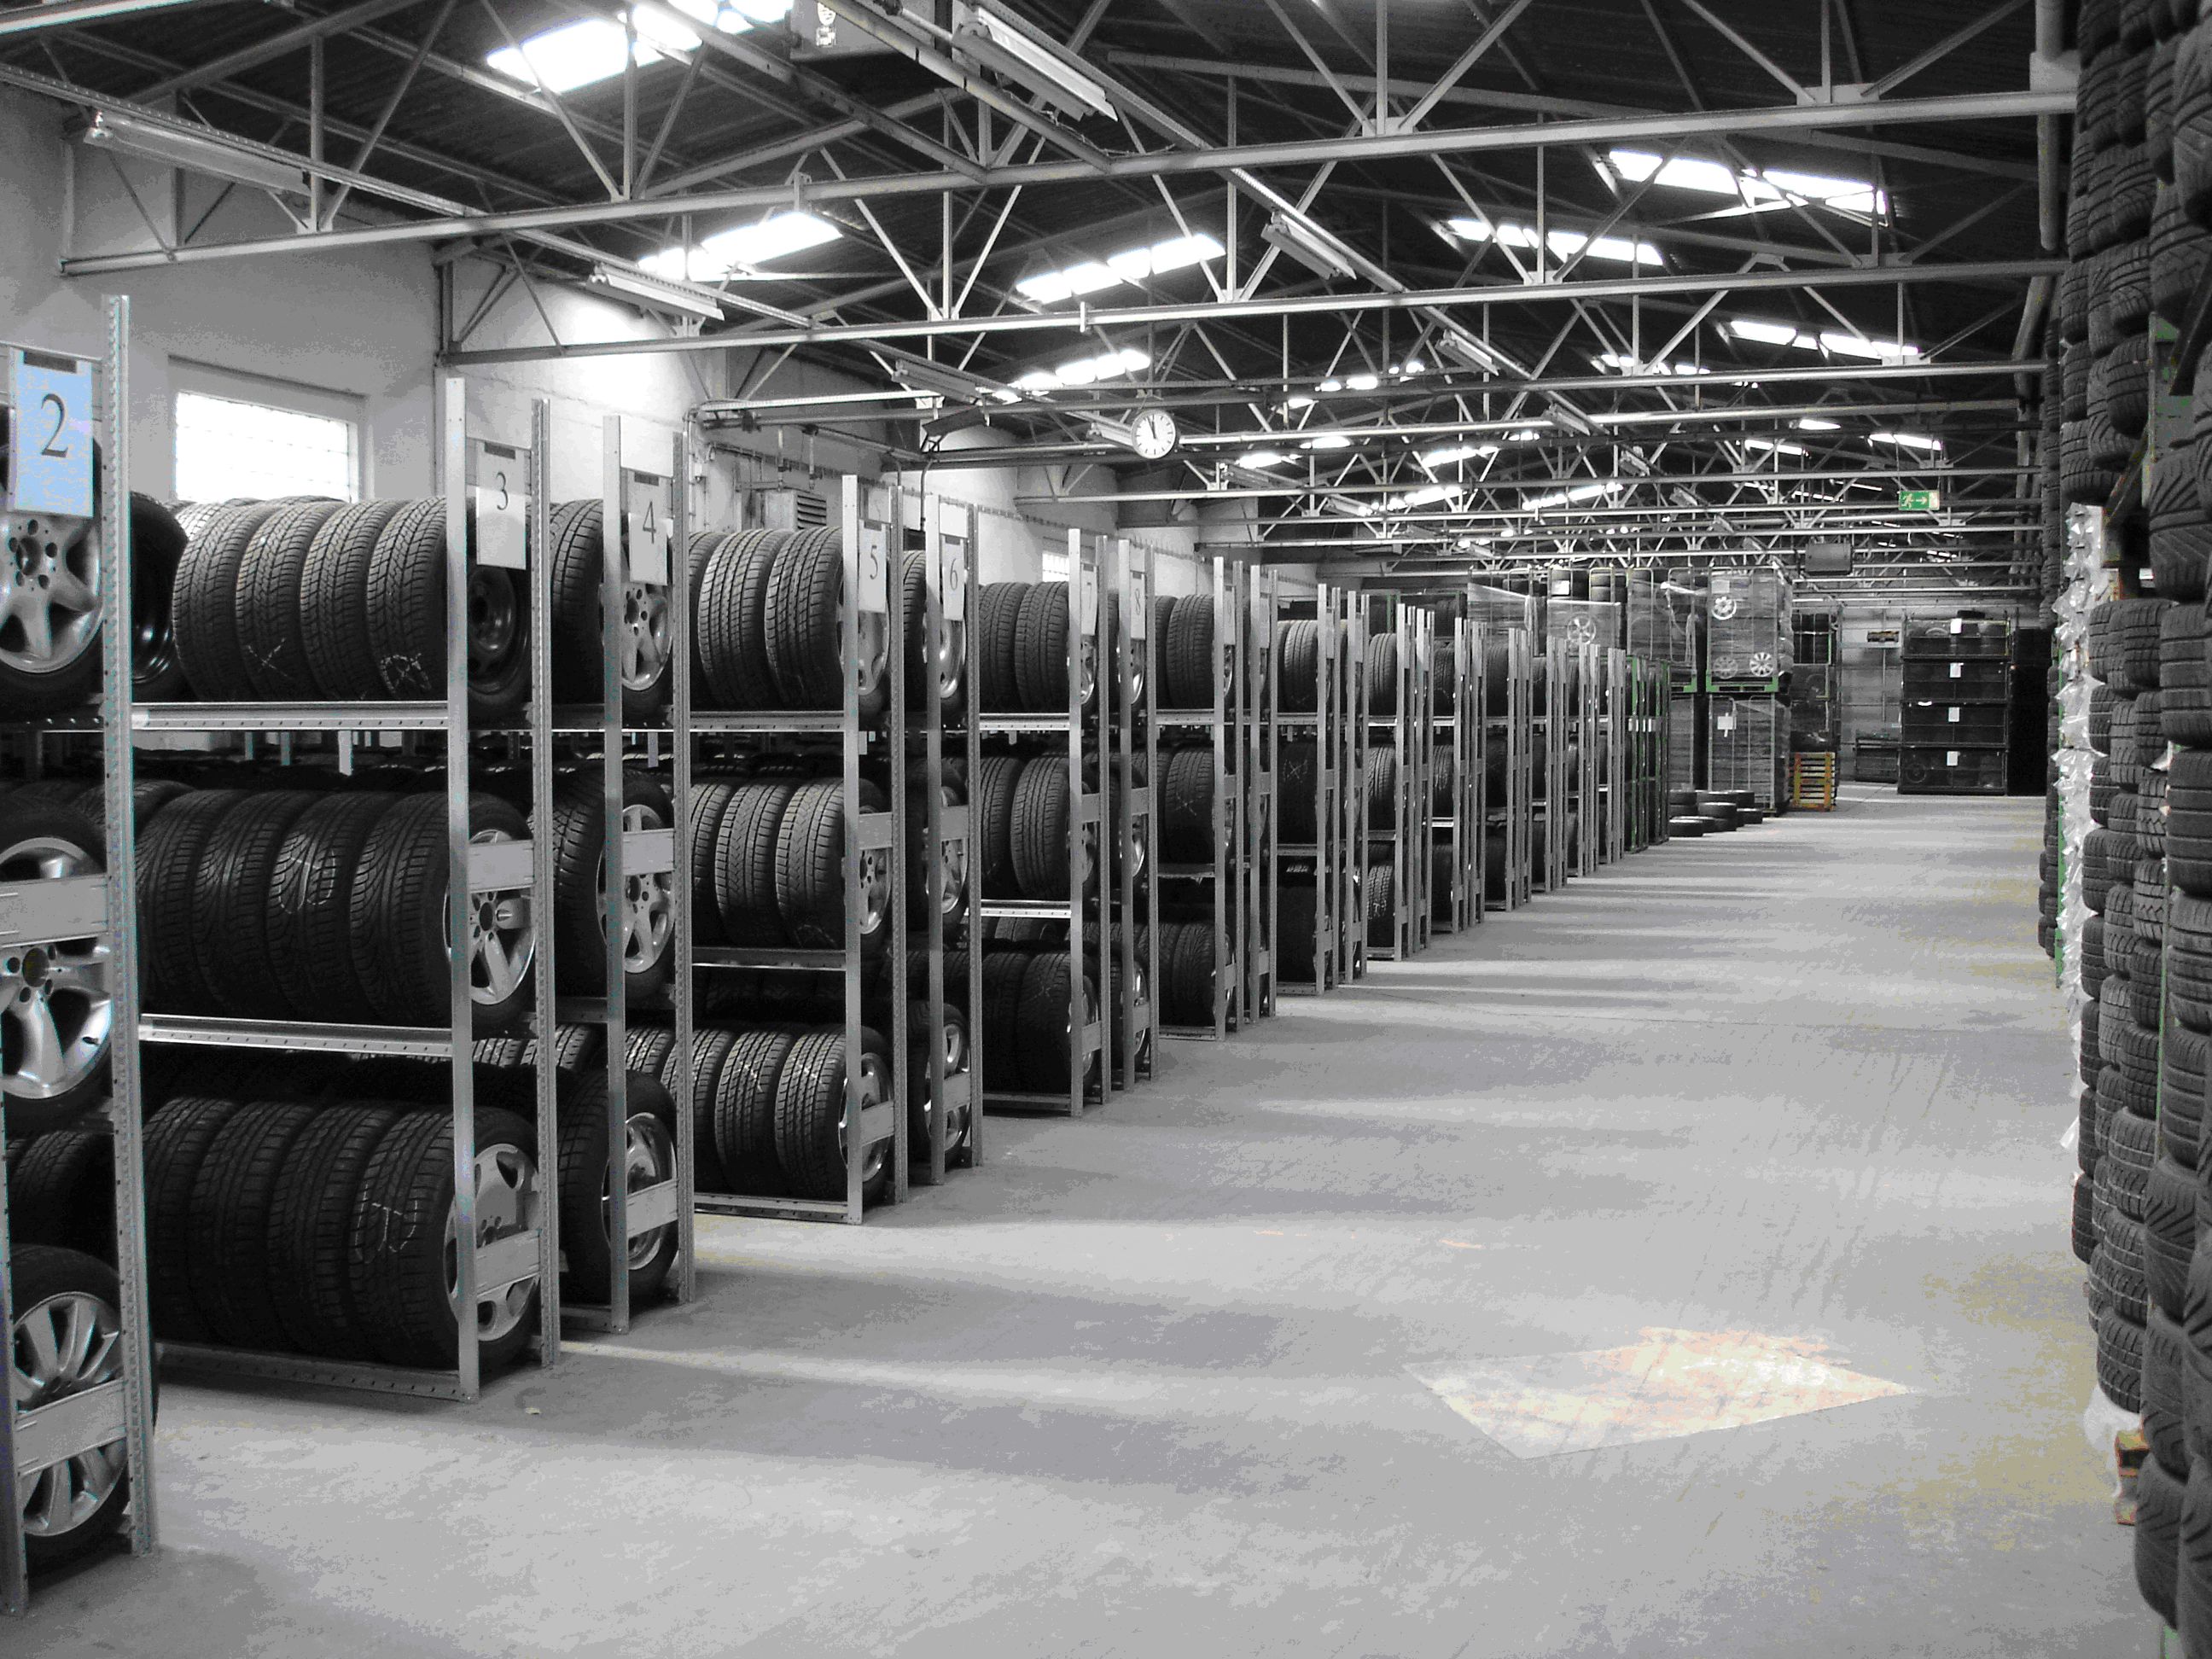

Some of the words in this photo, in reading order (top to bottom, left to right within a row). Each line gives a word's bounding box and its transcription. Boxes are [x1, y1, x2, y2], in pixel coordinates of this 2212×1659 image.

[41, 393, 69, 458] 2
[495, 471, 509, 511] 3
[642, 500, 657, 544] 4
[869, 544, 879, 580] 5
[949, 557, 958, 591] 6
[1134, 587, 1142, 615] 8
